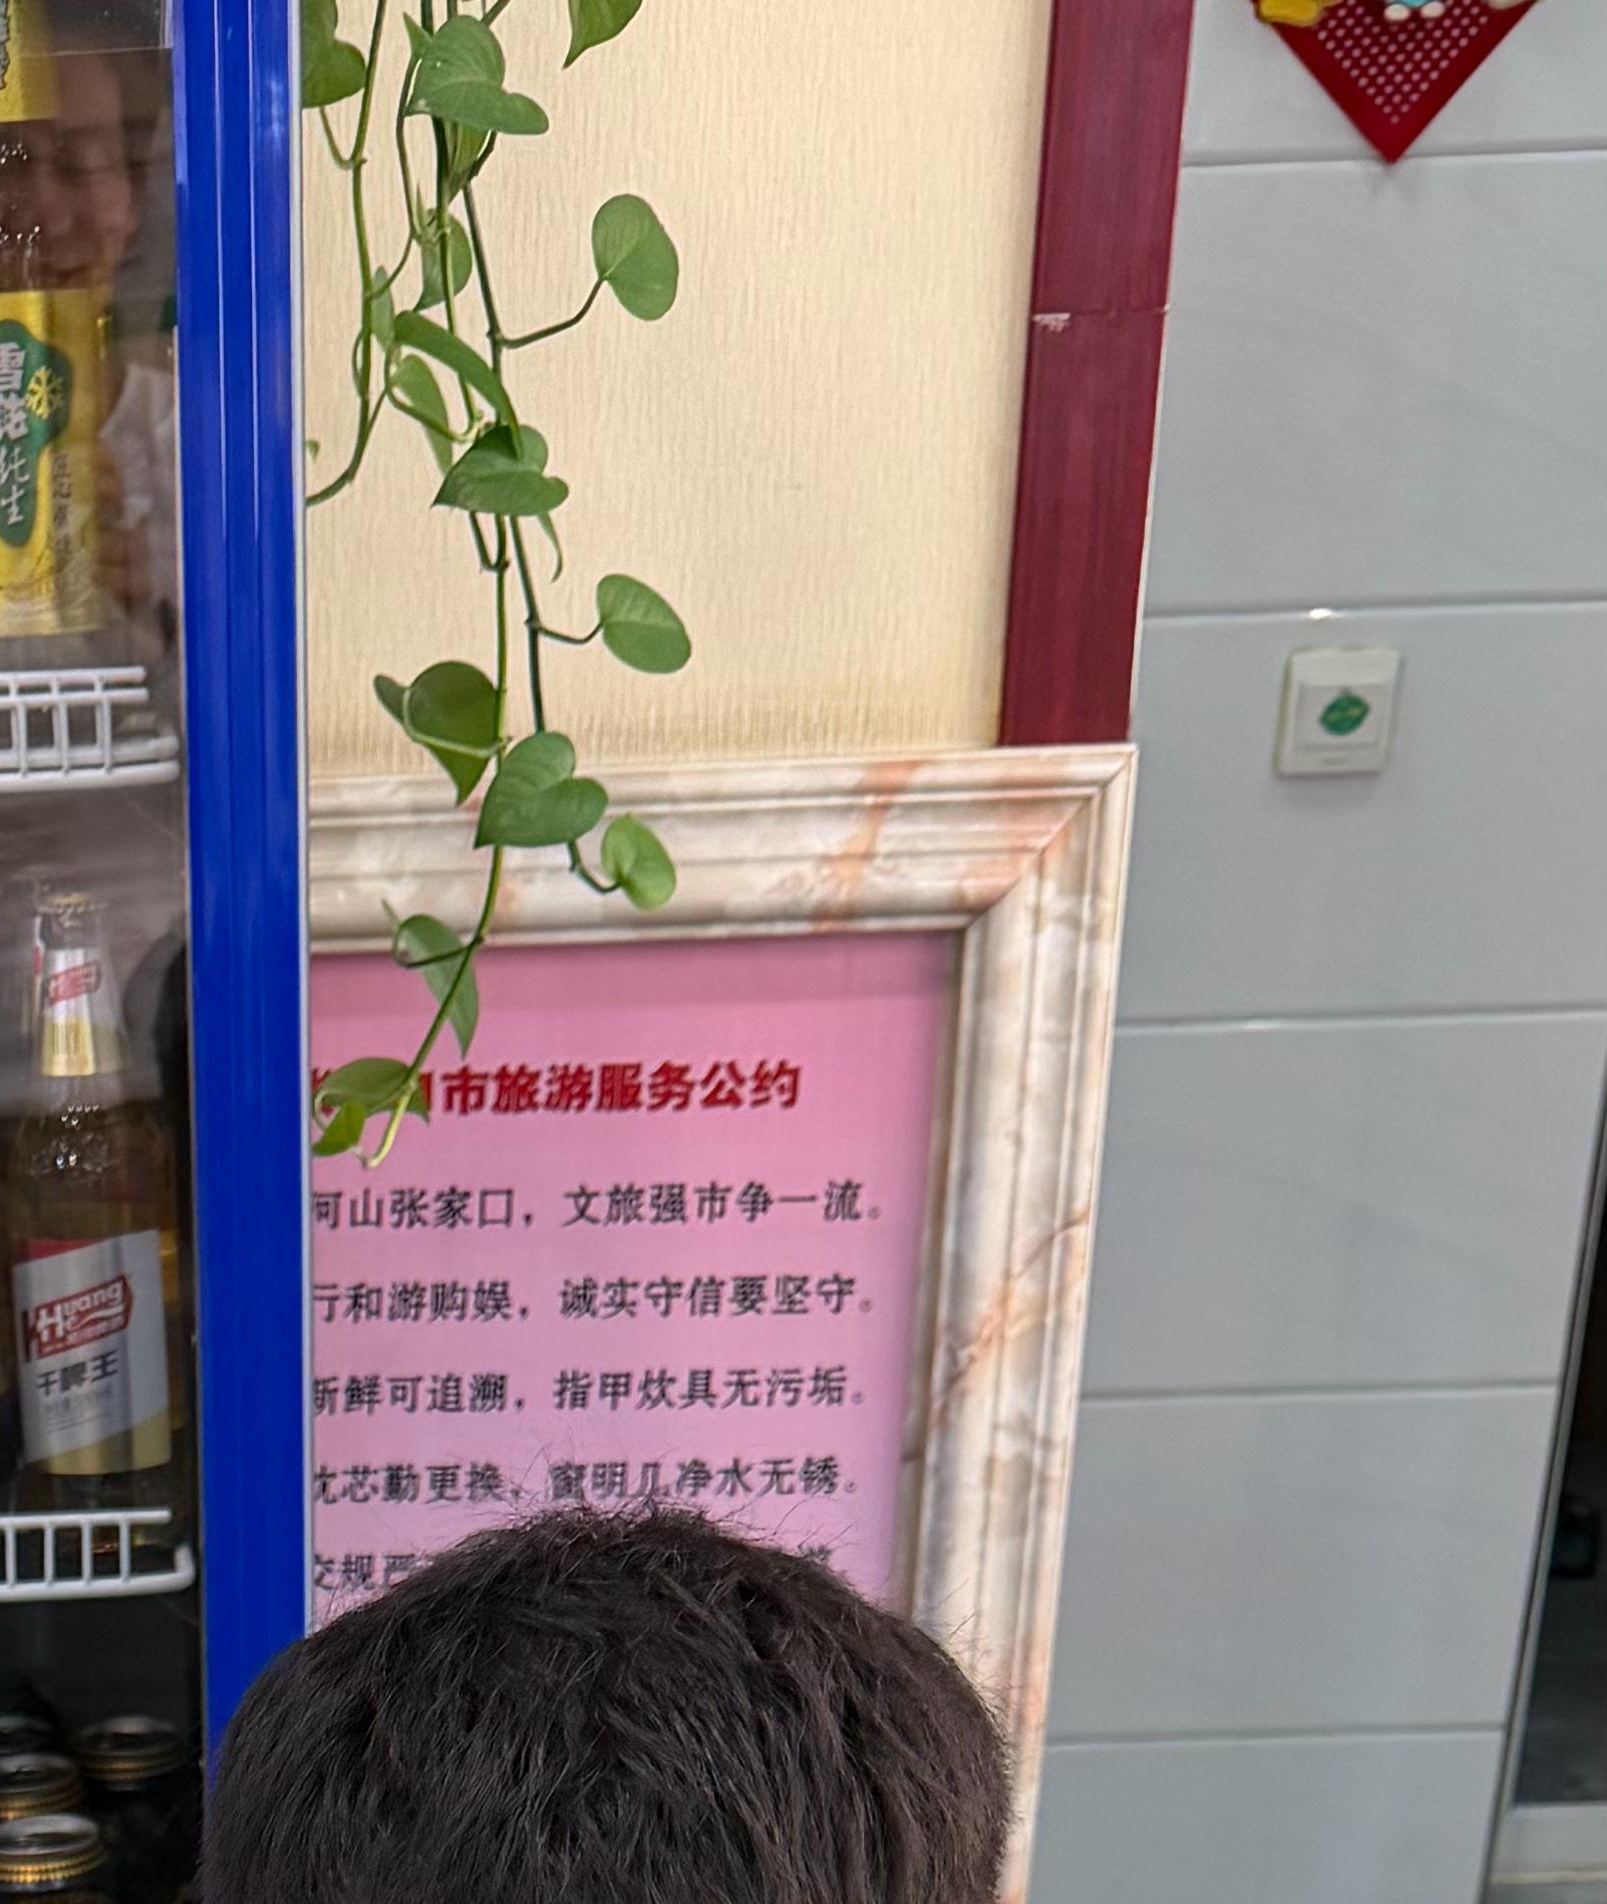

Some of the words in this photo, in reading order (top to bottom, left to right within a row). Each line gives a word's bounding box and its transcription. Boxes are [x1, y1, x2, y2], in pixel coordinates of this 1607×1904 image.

[312, 1060, 802, 1117] 市旅游服务公约
[36, 1351, 119, 1397] 干啤王
